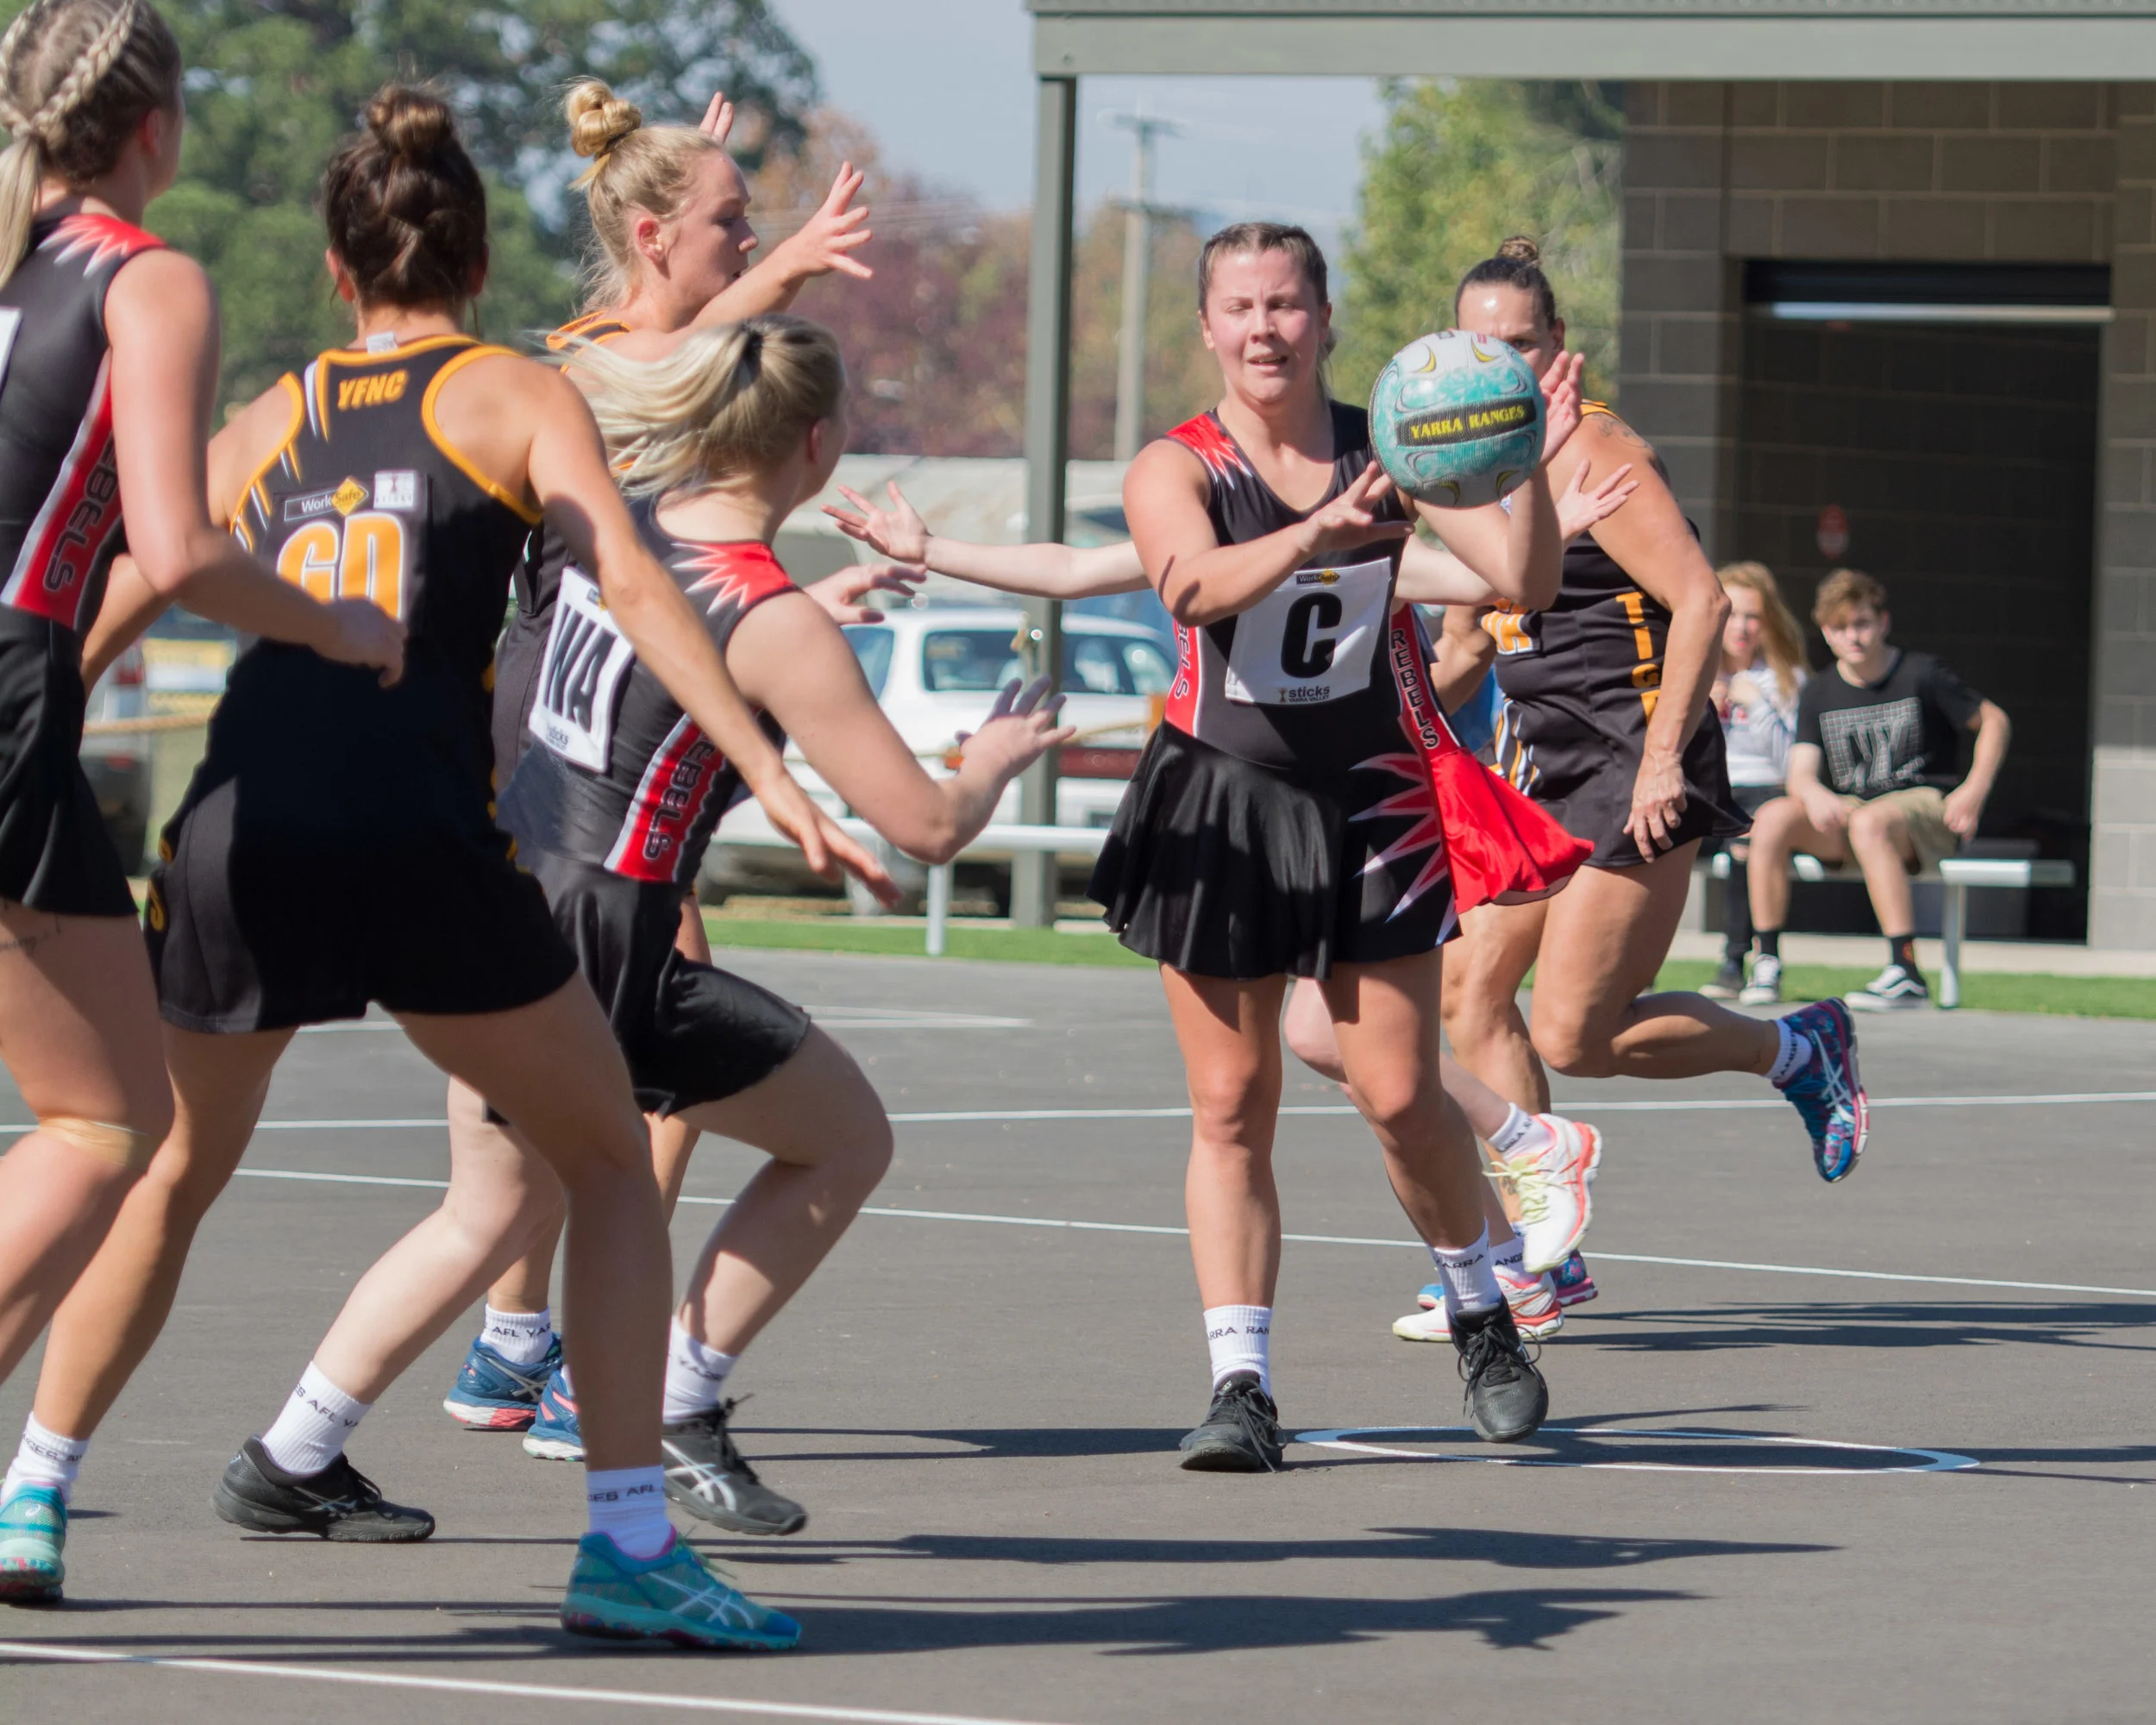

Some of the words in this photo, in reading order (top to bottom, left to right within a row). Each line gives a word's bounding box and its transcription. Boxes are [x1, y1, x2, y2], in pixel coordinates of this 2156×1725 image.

[336, 368, 407, 411] YFNC
[1410, 417, 1463, 440] YARRA
[1281, 592, 1342, 679] C
[542, 603, 619, 734] WA
[1288, 685, 1330, 699] sticks
[1389, 627, 1440, 750] REBELS
[492, 1326, 520, 1338] AFL
[307, 1399, 335, 1423] AFL
